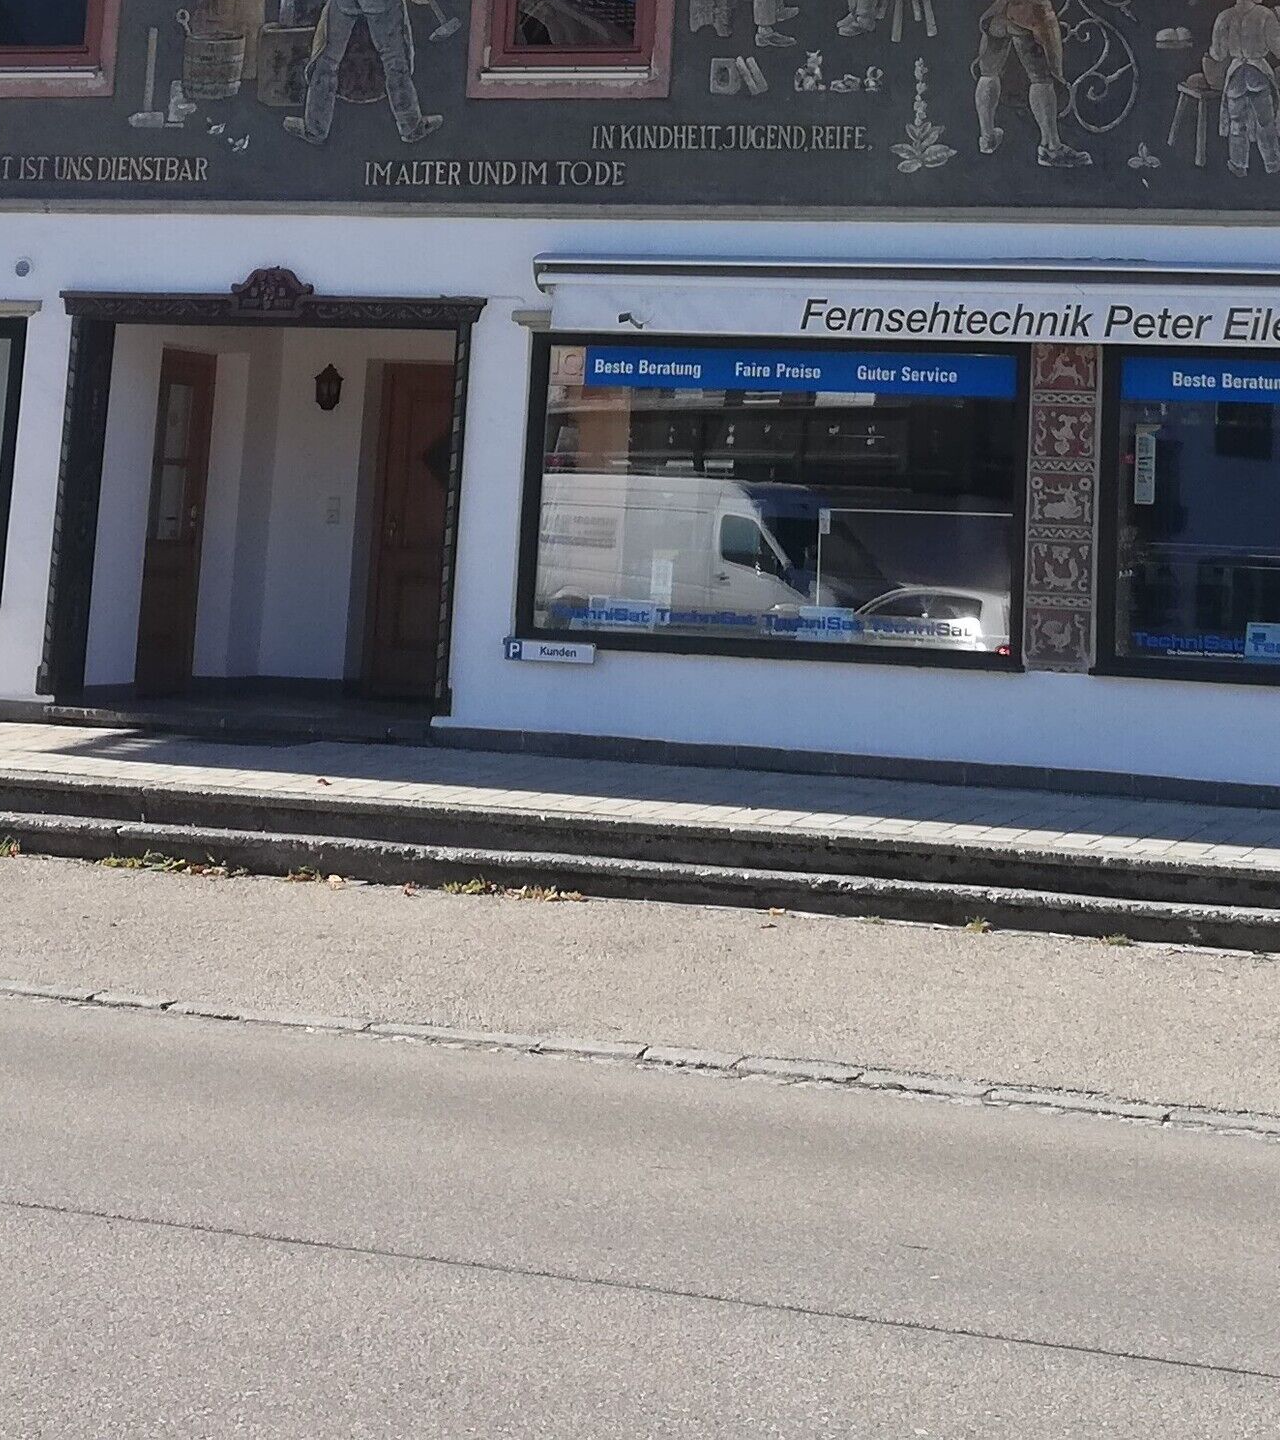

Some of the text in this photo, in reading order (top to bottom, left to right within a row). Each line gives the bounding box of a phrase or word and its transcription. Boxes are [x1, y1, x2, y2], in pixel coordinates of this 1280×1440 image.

[591, 124, 614, 149] IN
[19, 157, 50, 180] IST
[54, 157, 93, 181] UNS
[96, 157, 209, 181] DIENSTBAR
[364, 161, 627, 186] IM ALTER UND IM TODE
[801, 298, 1092, 338] Fernsehtechnik
[1104, 305, 1213, 340] Peter
[594, 358, 958, 384] Beste Beratung Faire Preise Guter Service
[1172, 371, 1217, 388] Beste
[509, 642, 577, 658] P Kunden
